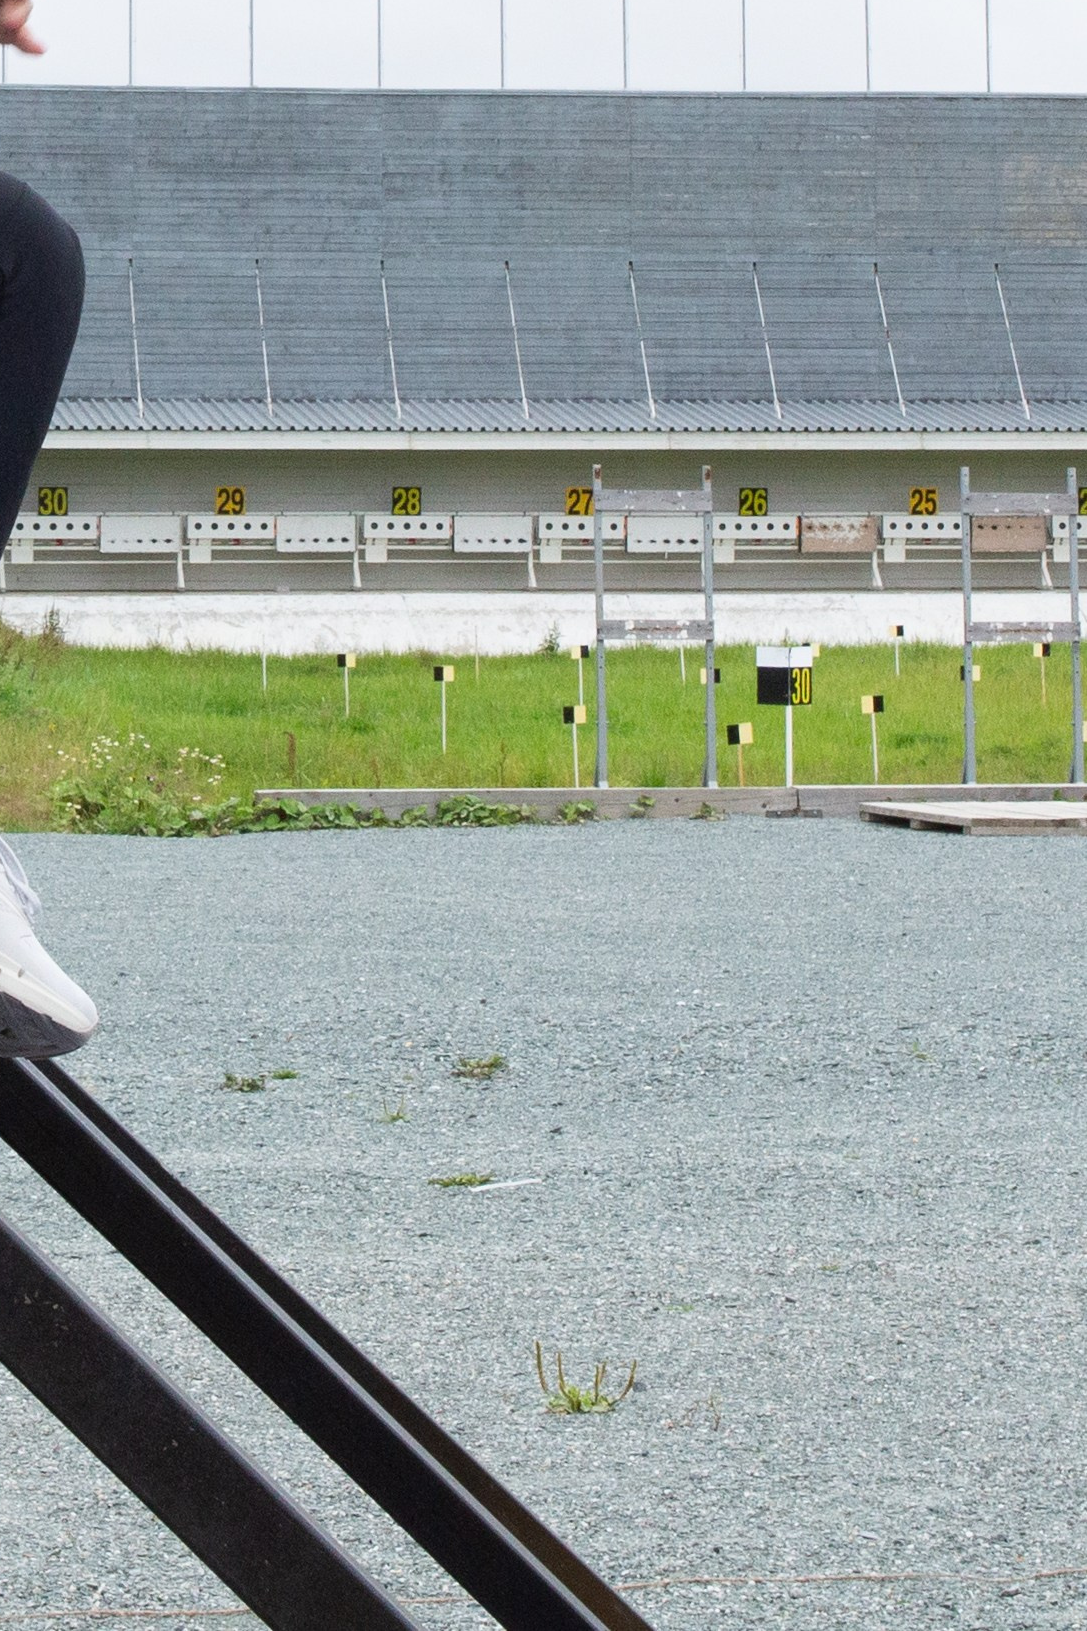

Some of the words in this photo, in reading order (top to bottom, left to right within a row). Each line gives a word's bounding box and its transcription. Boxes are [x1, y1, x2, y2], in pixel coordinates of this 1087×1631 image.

[39, 488, 67, 515] 30
[217, 488, 244, 515] 29
[393, 488, 420, 515] 28
[568, 488, 594, 515] 27
[740, 489, 767, 516] 26
[911, 488, 937, 516] 25
[792, 668, 810, 704] 30
